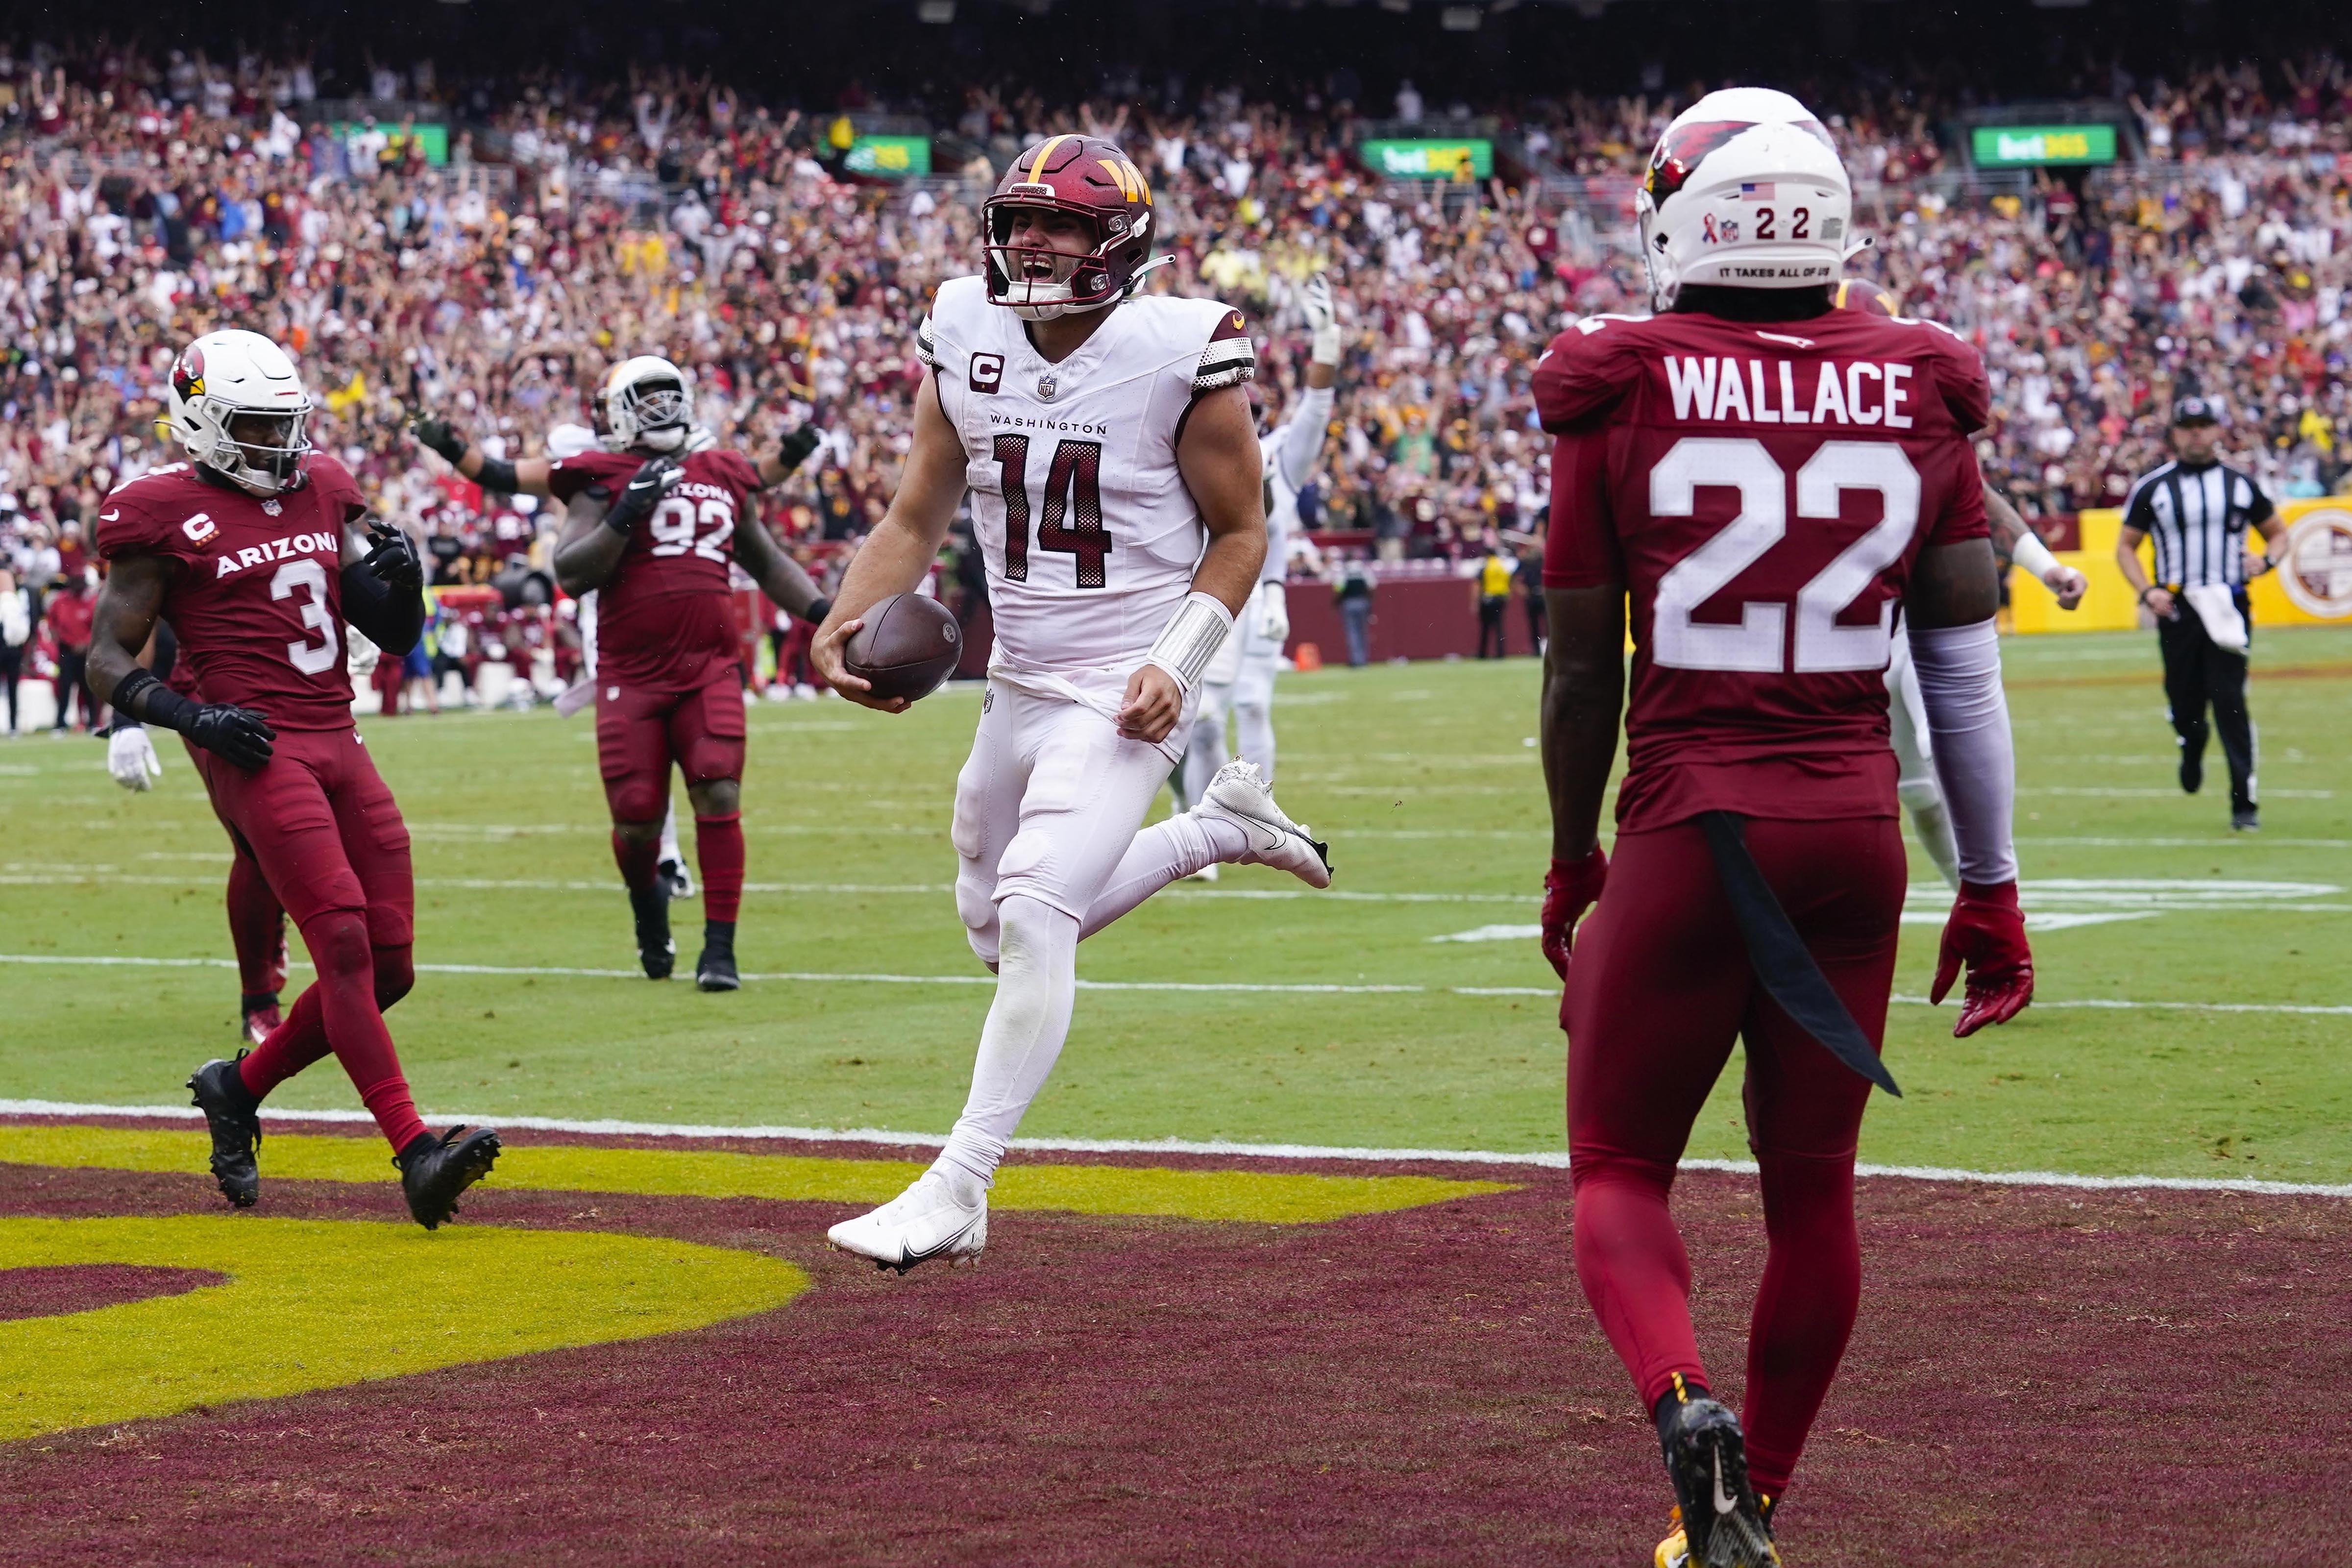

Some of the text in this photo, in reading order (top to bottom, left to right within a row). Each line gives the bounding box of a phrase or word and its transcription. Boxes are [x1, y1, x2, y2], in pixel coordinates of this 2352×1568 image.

[1720, 268, 1730, 277] IT
[1735, 268, 1774, 277] TAKES
[1779, 268, 1799, 277] ALL
[991, 415, 1107, 435] WASHINGTON
[1040, 385, 1052, 394] NFL
[1664, 355, 1913, 429] WALLACE
[650, 496, 734, 564] 92
[992, 433, 1112, 588] 14
[1649, 437, 1921, 673] 22
[270, 558, 339, 675] 3
